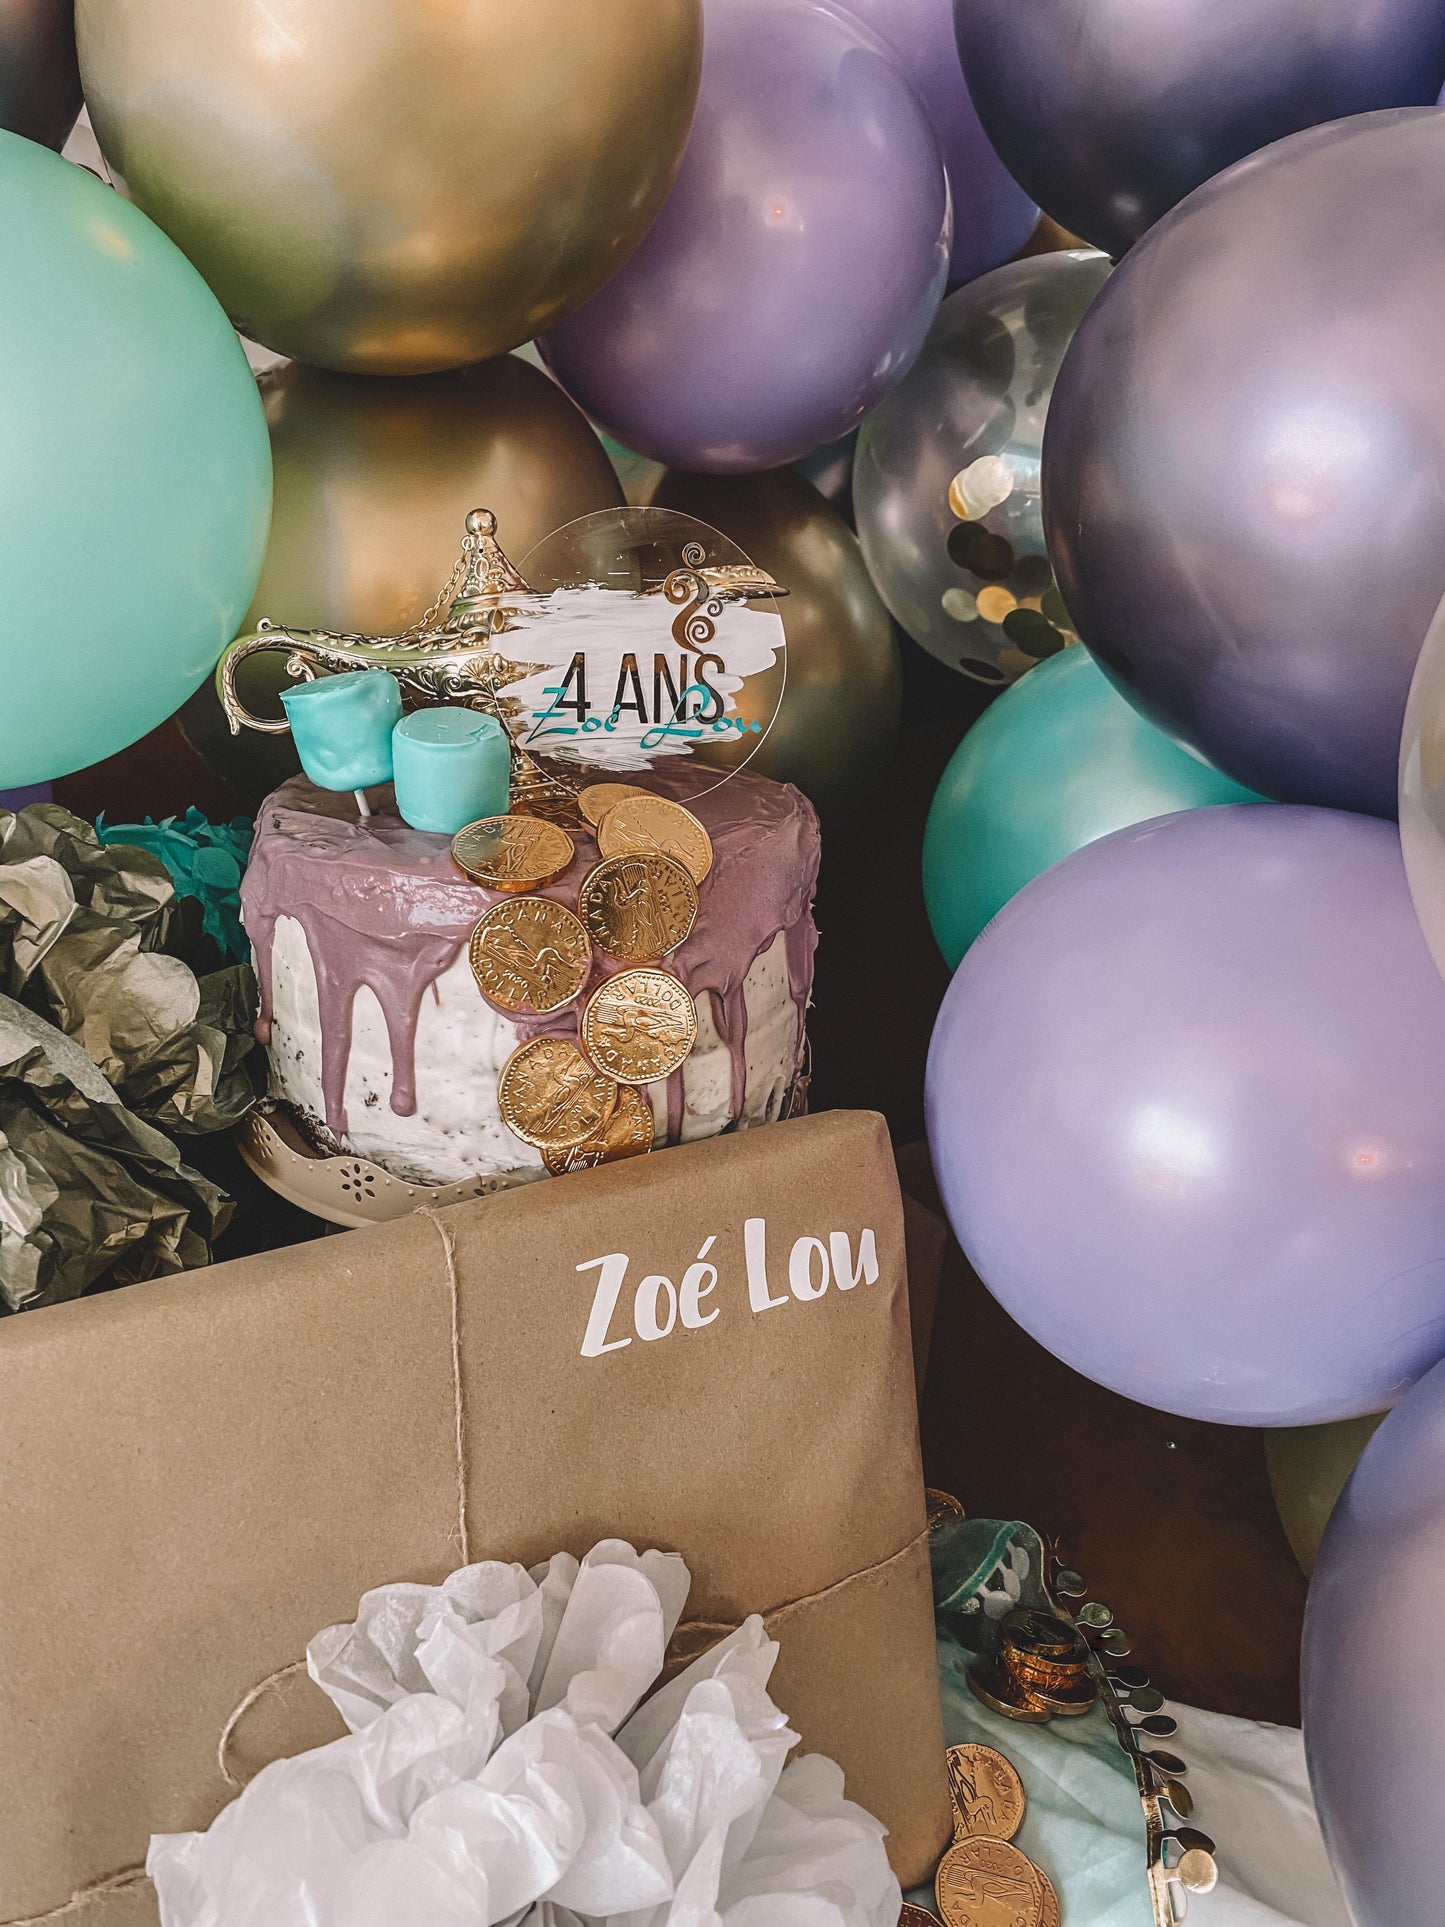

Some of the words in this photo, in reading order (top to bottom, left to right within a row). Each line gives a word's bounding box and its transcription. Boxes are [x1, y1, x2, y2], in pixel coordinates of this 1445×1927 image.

[553, 651, 591, 723] 4
[612, 652, 725, 725] ANS
[525, 686, 621, 744] Zoé
[640, 684, 762, 749] Lou
[480, 958, 547, 1003] DOLLAR
[612, 979, 682, 1011] DOLLAR
[575, 1235, 720, 1358] Zoé
[744, 1217, 879, 1313] Lou
[960, 1847, 1025, 1876] DOLLAR
